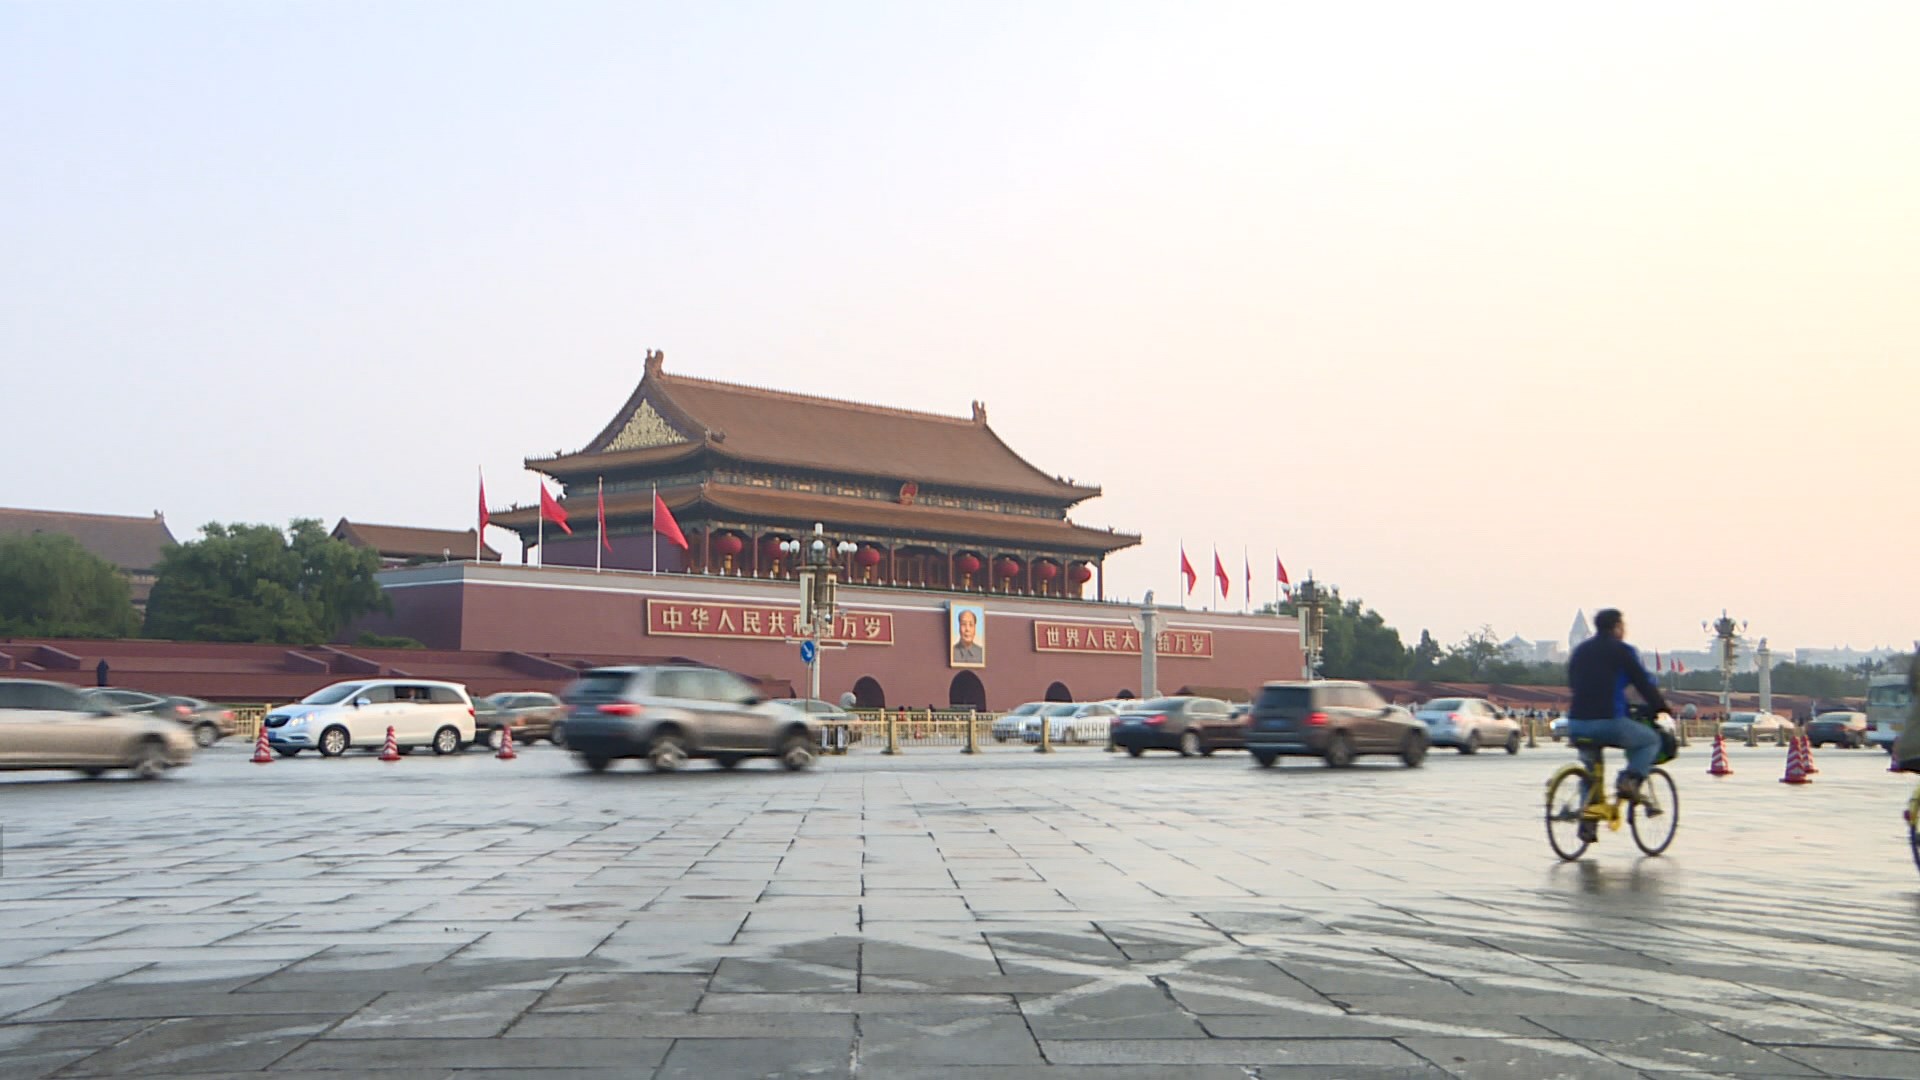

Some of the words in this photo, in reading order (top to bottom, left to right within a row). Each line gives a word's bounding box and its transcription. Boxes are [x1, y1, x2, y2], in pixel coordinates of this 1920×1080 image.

[662, 606, 881, 639] 中华人民共万岁
[1046, 626, 1204, 653] 世界人民大结万岁
